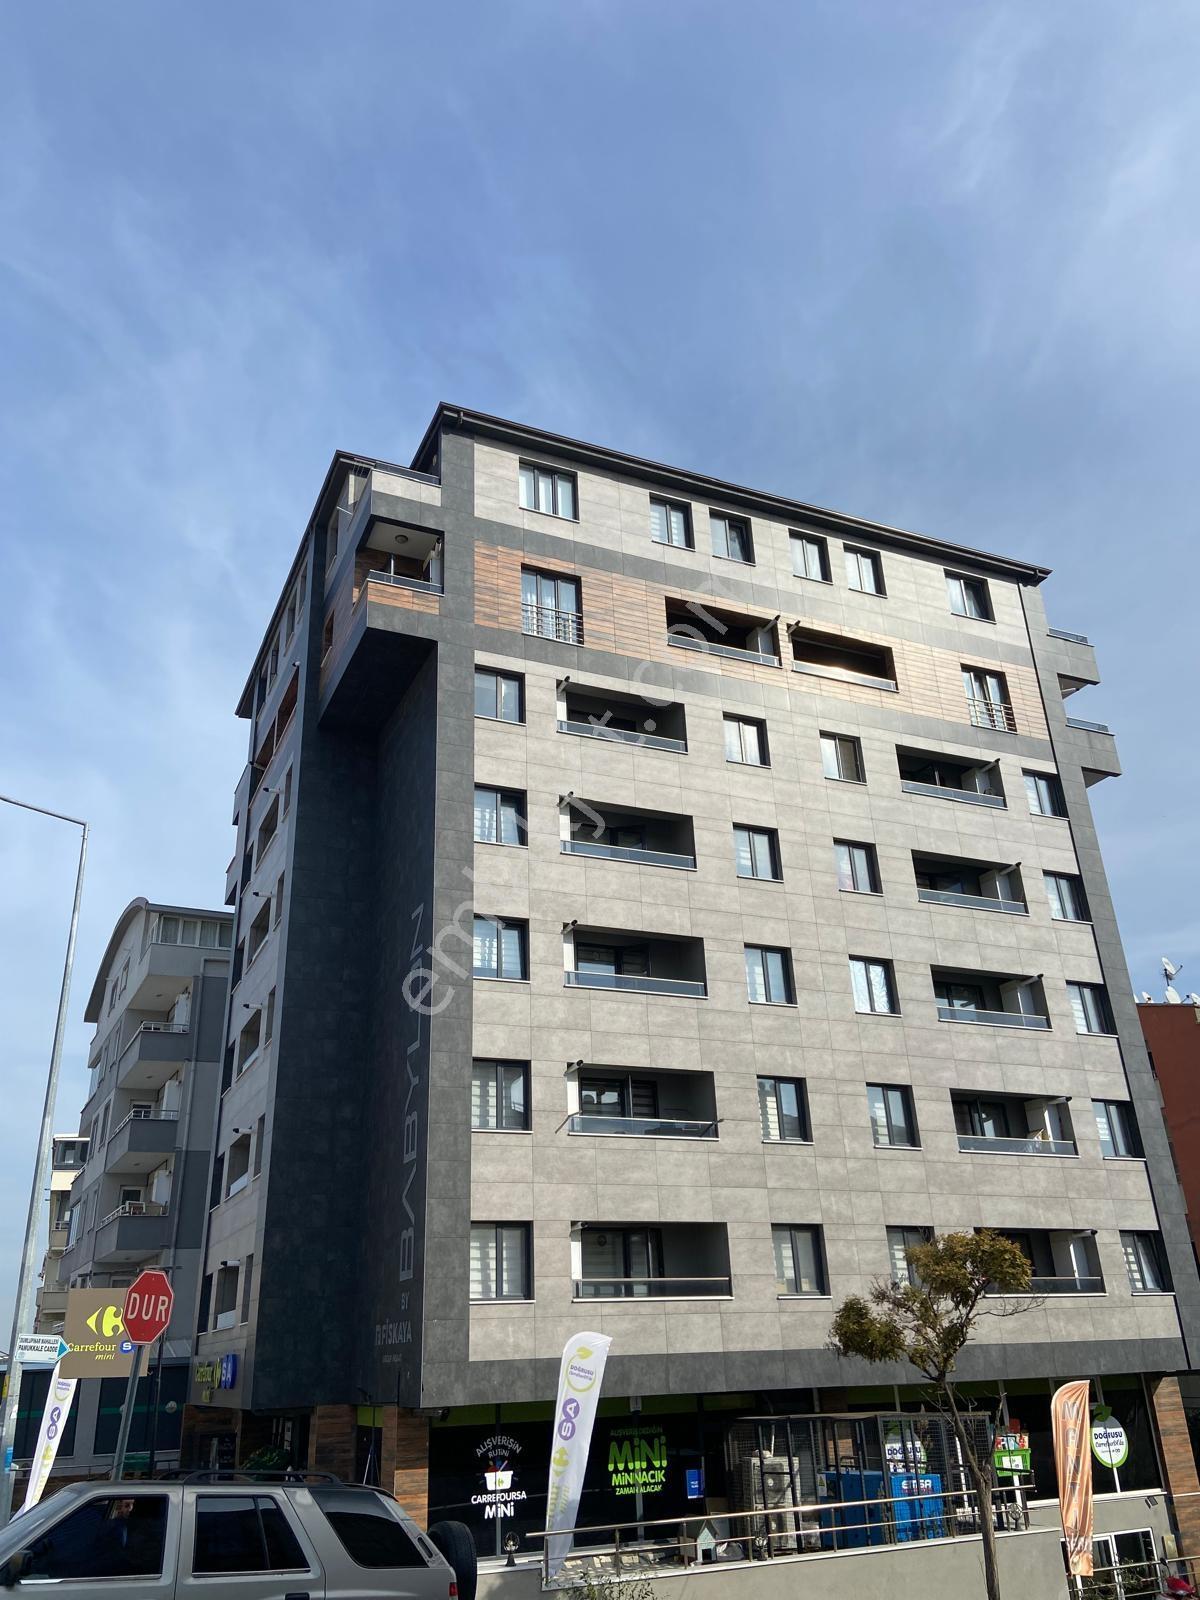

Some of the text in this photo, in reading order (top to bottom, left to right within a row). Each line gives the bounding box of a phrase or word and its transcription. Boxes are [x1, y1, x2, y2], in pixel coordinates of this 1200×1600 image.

[127, 1292, 169, 1322] DUR
[68, 1342, 117, 1352] Carrefour
[95, 1353, 116, 1361] mini
[561, 1402, 578, 1437] SA
[471, 1490, 527, 1505] CARREFOURSA
